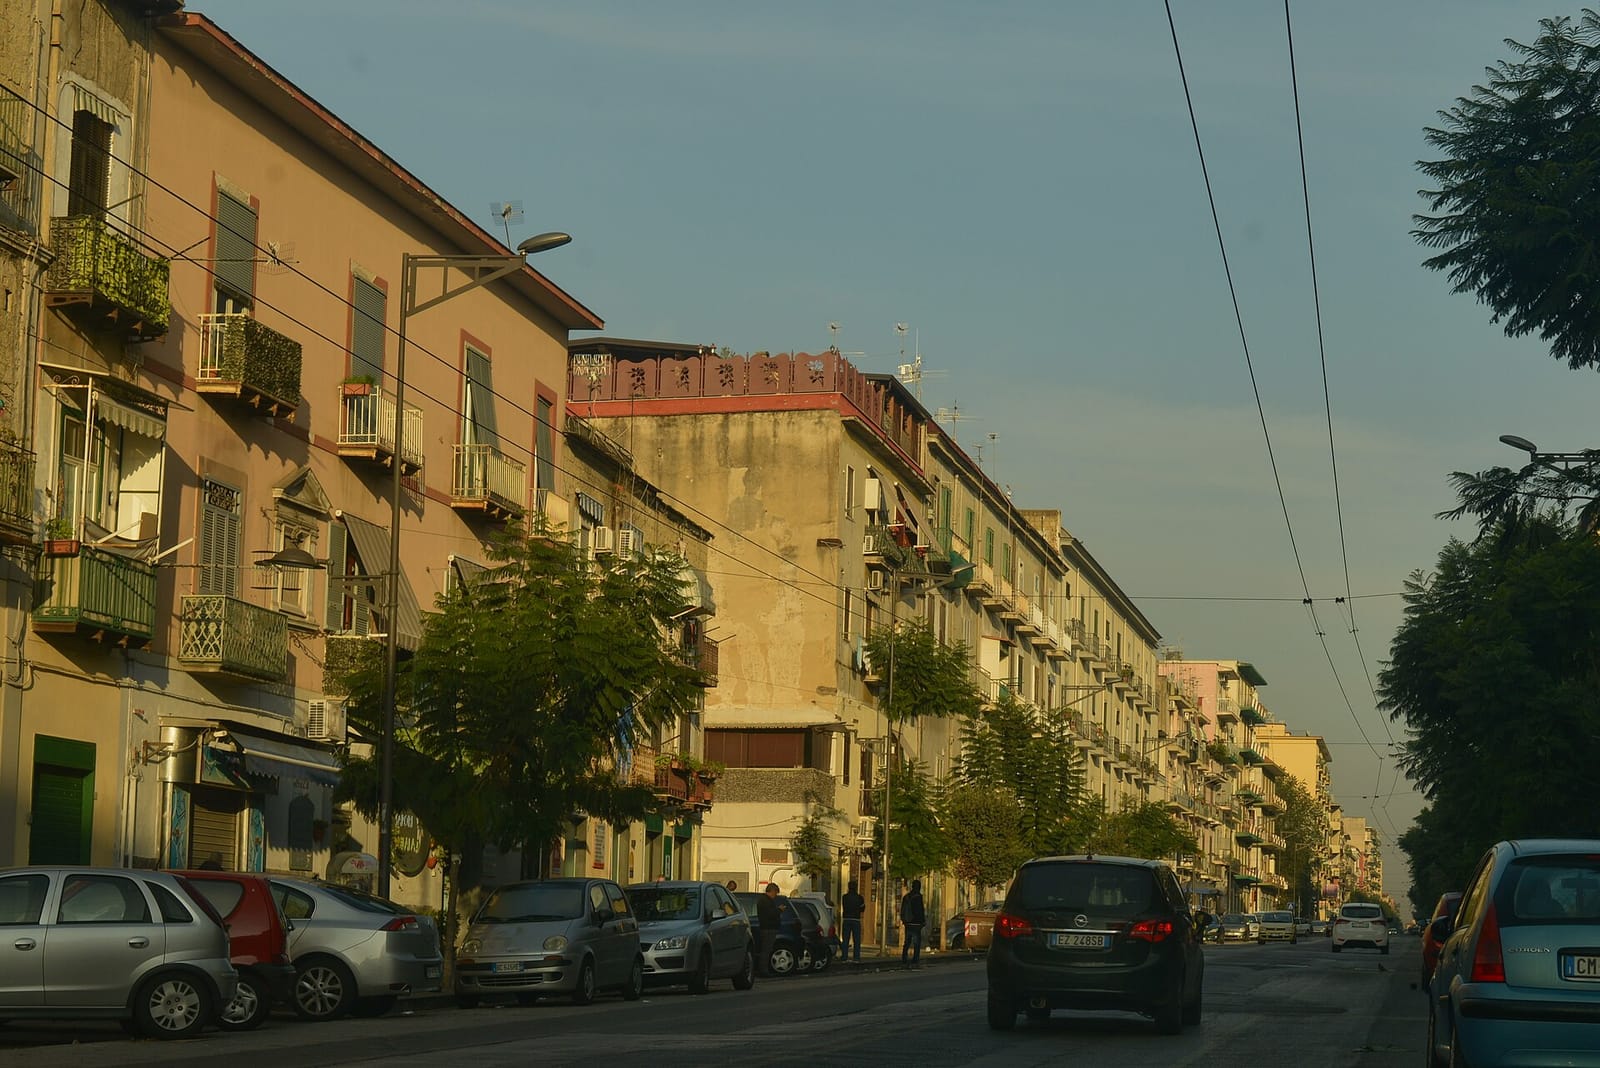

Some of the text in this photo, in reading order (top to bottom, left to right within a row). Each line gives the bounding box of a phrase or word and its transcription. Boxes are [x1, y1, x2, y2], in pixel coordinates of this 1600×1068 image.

[1058, 935, 1104, 946] EZ 248SB
[1577, 958, 1597, 975] CM
